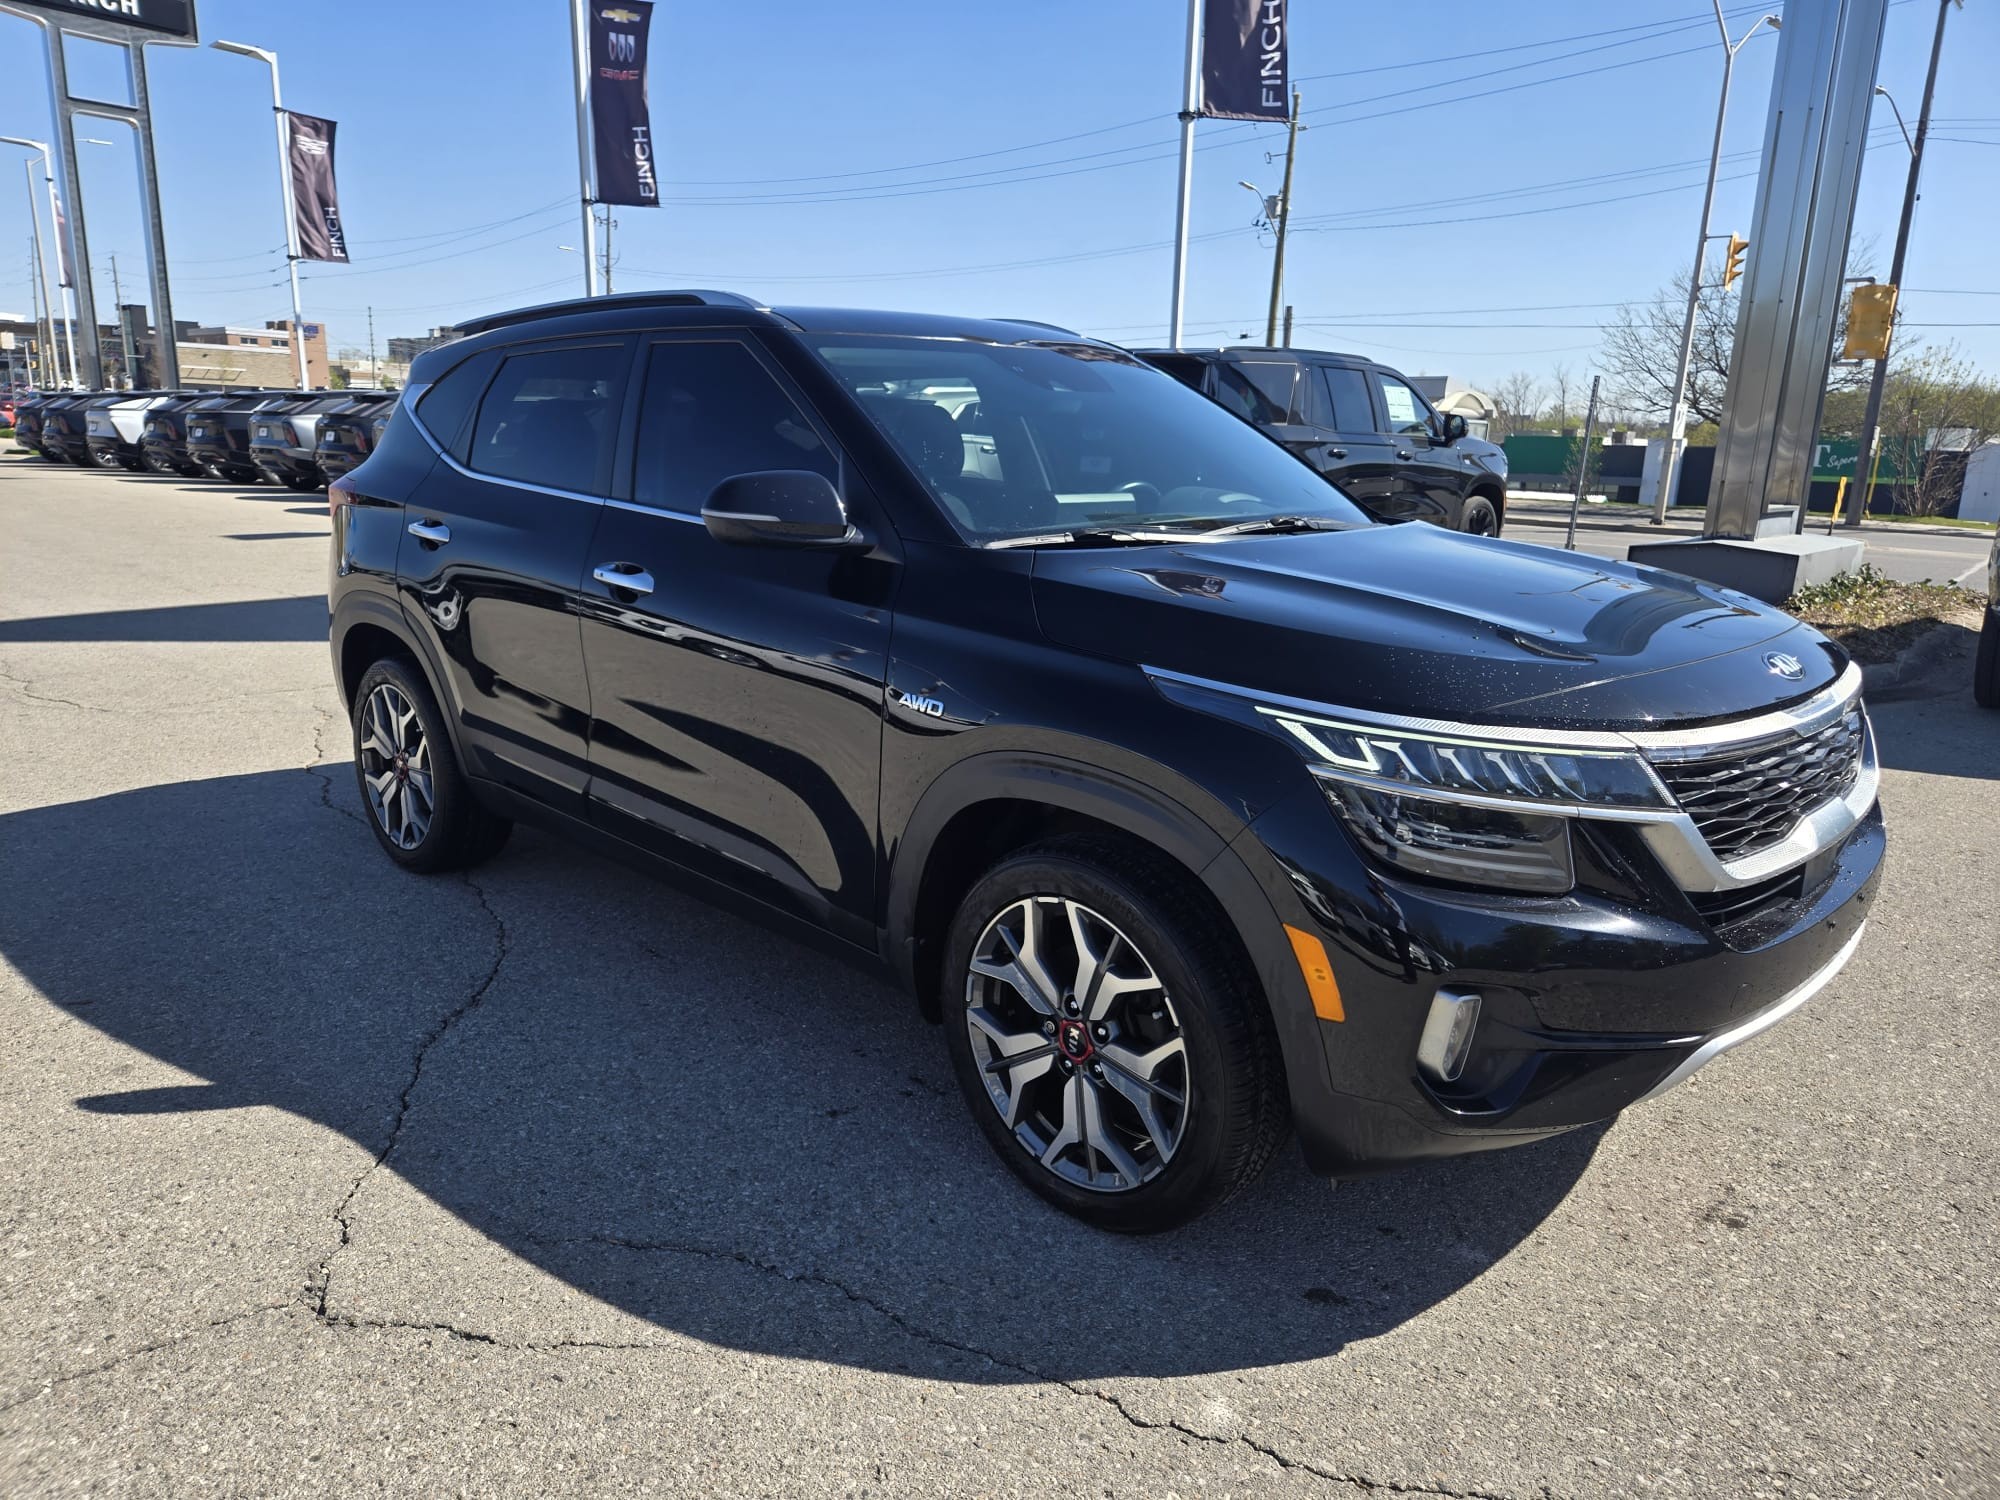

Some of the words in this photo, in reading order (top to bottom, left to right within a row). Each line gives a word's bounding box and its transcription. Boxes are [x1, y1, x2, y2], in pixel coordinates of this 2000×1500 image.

[1261, 0, 1283, 107] FINCH
[599, 67, 640, 80] GMC
[632, 126, 656, 197] FINCH
[324, 207, 346, 257] FINCH
[898, 692, 945, 717] AWD
[1068, 1027, 1081, 1054] KIA
